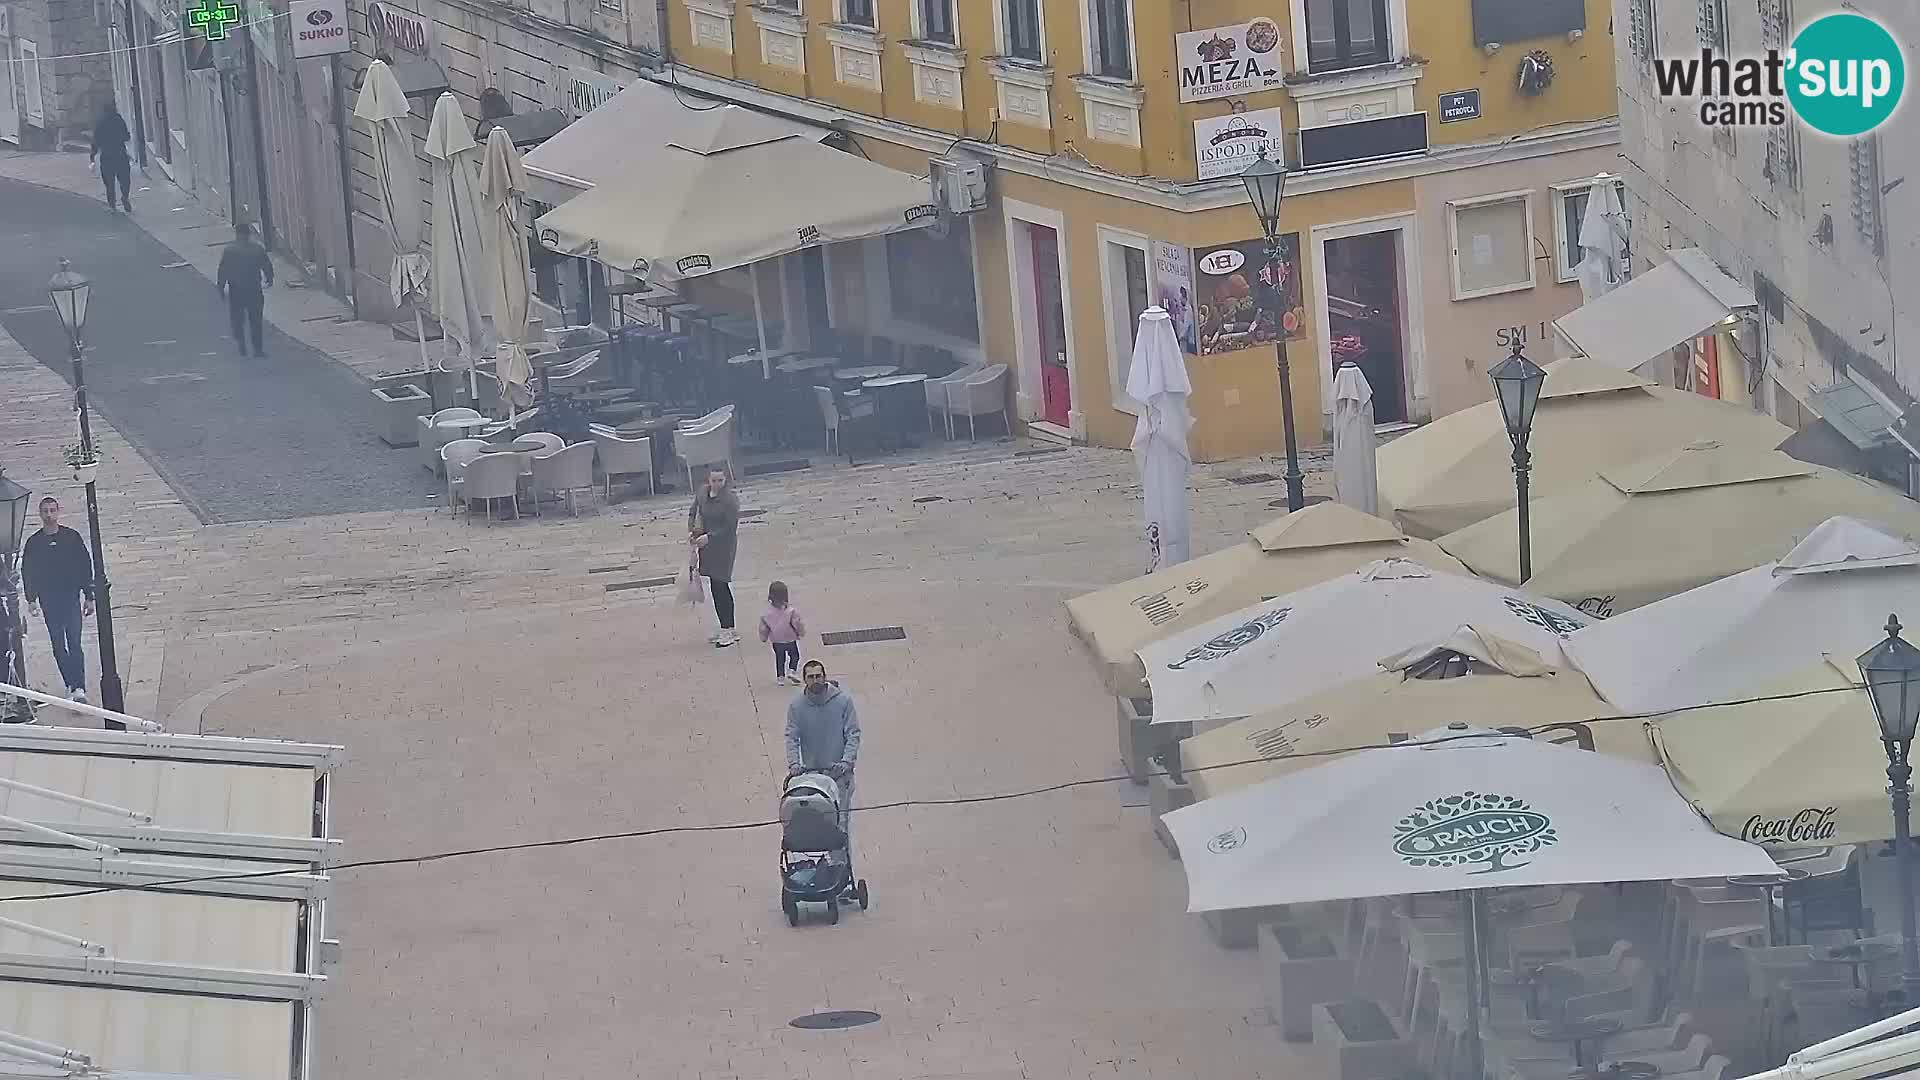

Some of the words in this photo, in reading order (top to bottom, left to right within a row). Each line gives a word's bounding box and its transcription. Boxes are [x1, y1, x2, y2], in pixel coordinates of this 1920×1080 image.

[197, 10, 227, 22] 05:31
[299, 27, 344, 41] SUKNO
[385, 11, 424, 49] SUKNO
[1182, 57, 1262, 87] MEZA
[1192, 84, 1224, 96] PIZZERIA
[1225, 82, 1231, 91] &
[1232, 79, 1253, 90] GRILL
[1201, 143, 1247, 161] ISPOD
[1496, 325, 1527, 347] SM
[1432, 816, 1532, 847] RAUCH
